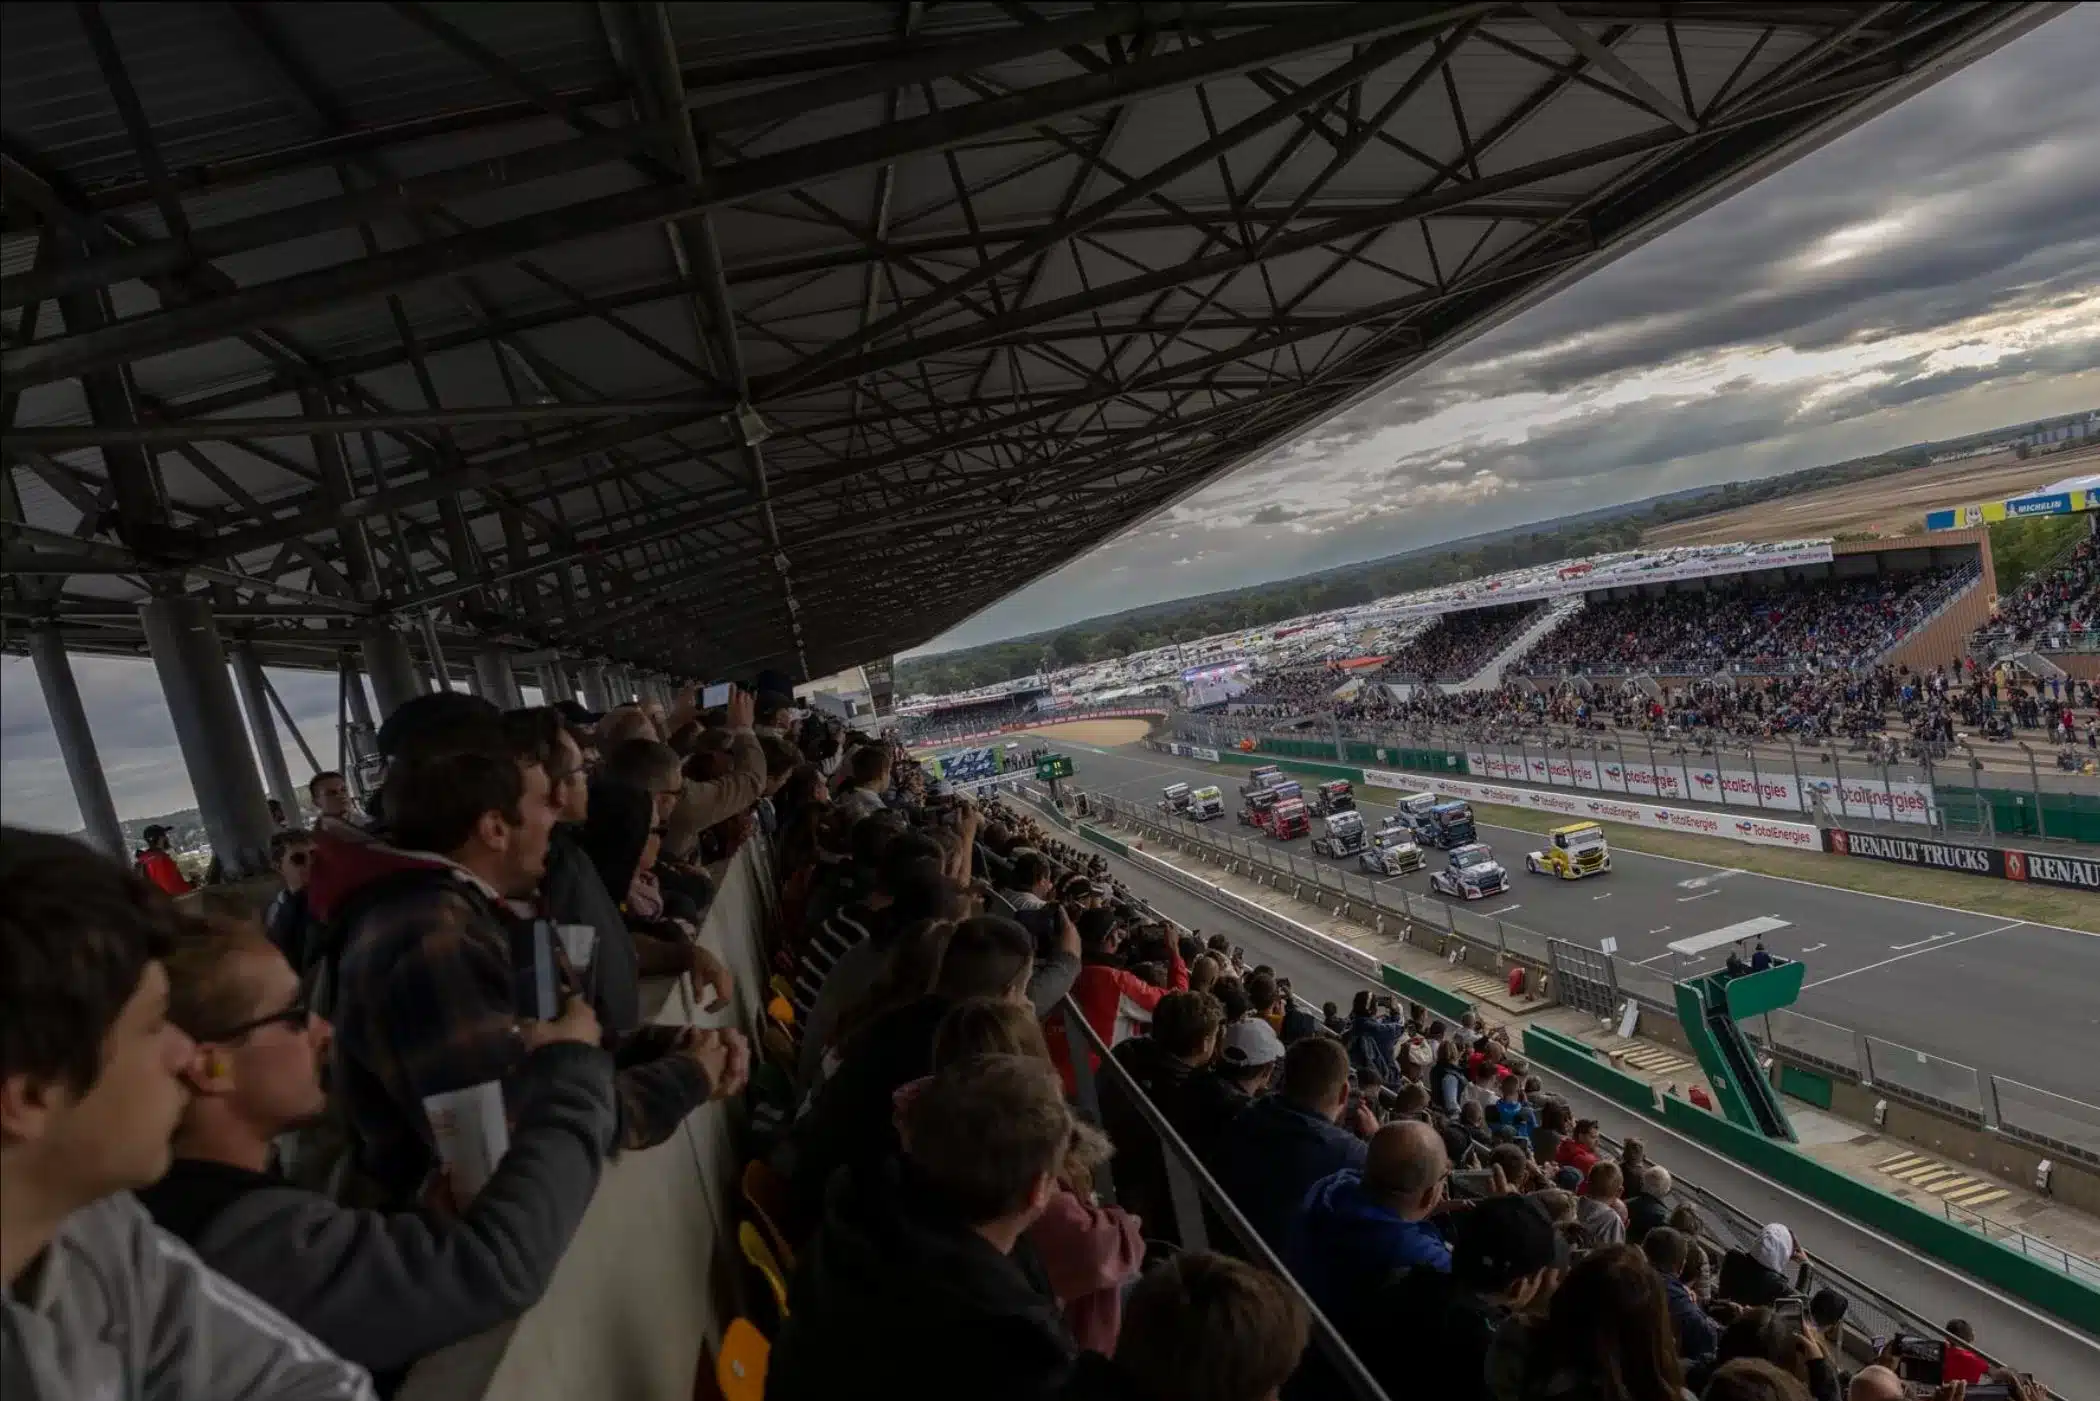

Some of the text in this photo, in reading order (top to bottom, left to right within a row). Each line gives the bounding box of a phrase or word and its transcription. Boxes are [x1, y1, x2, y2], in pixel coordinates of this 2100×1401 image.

[2018, 500, 2062, 512] MICHELIN
[1718, 777, 1787, 800] otalEnrgies
[1669, 813, 1718, 830] TotalEnergies
[1752, 824, 1811, 844] TotalEnergies
[1848, 834, 1990, 871] RENAULT TRUCKS
[2028, 856, 2100, 886] RENAU
